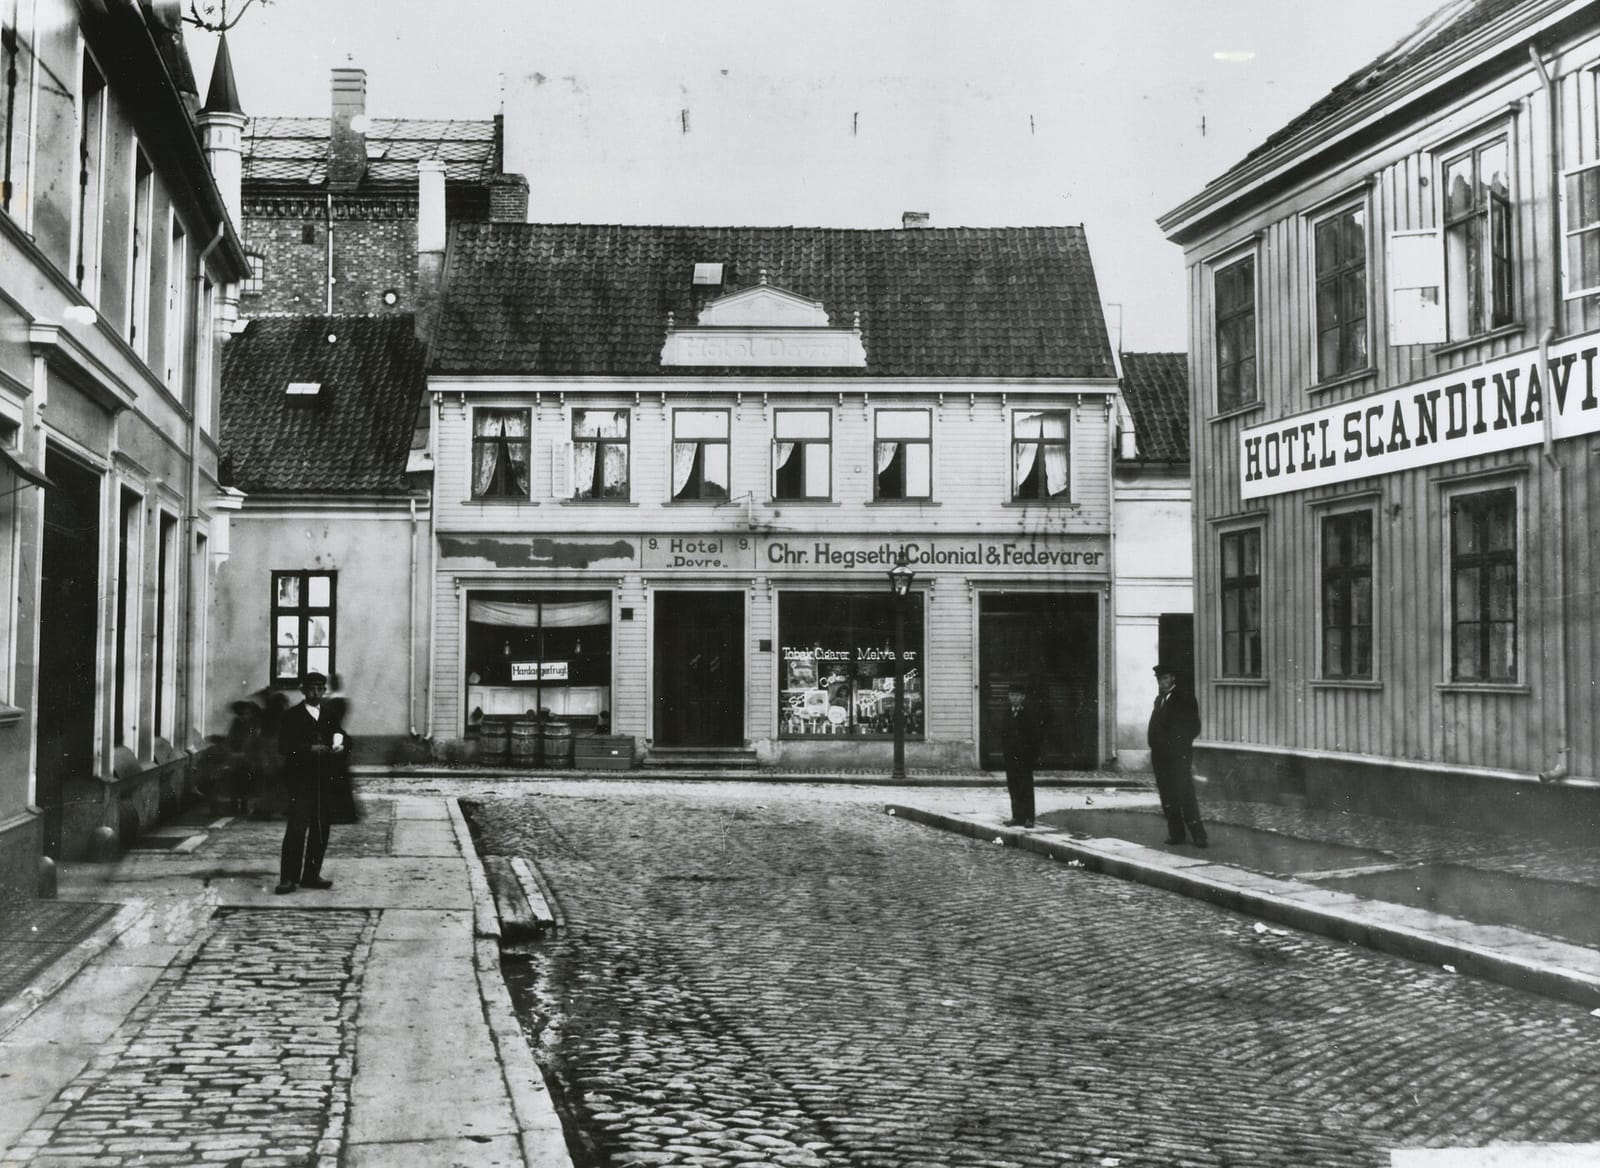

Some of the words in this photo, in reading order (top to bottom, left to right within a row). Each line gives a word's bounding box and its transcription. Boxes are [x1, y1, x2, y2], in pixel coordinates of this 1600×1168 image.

[1245, 419, 1336, 482] HOTEL
[649, 538, 660, 550] 9.
[670, 539, 723, 553] Hotel
[739, 539, 751, 550] 9.
[767, 543, 808, 564] Chr.
[814, 543, 898, 569] Hegseth
[905, 543, 982, 564] Colonial
[986, 545, 1000, 565] &
[1003, 544, 1104, 565] Fedevarer
[512, 665, 567, 677] Hardagerfrugt
